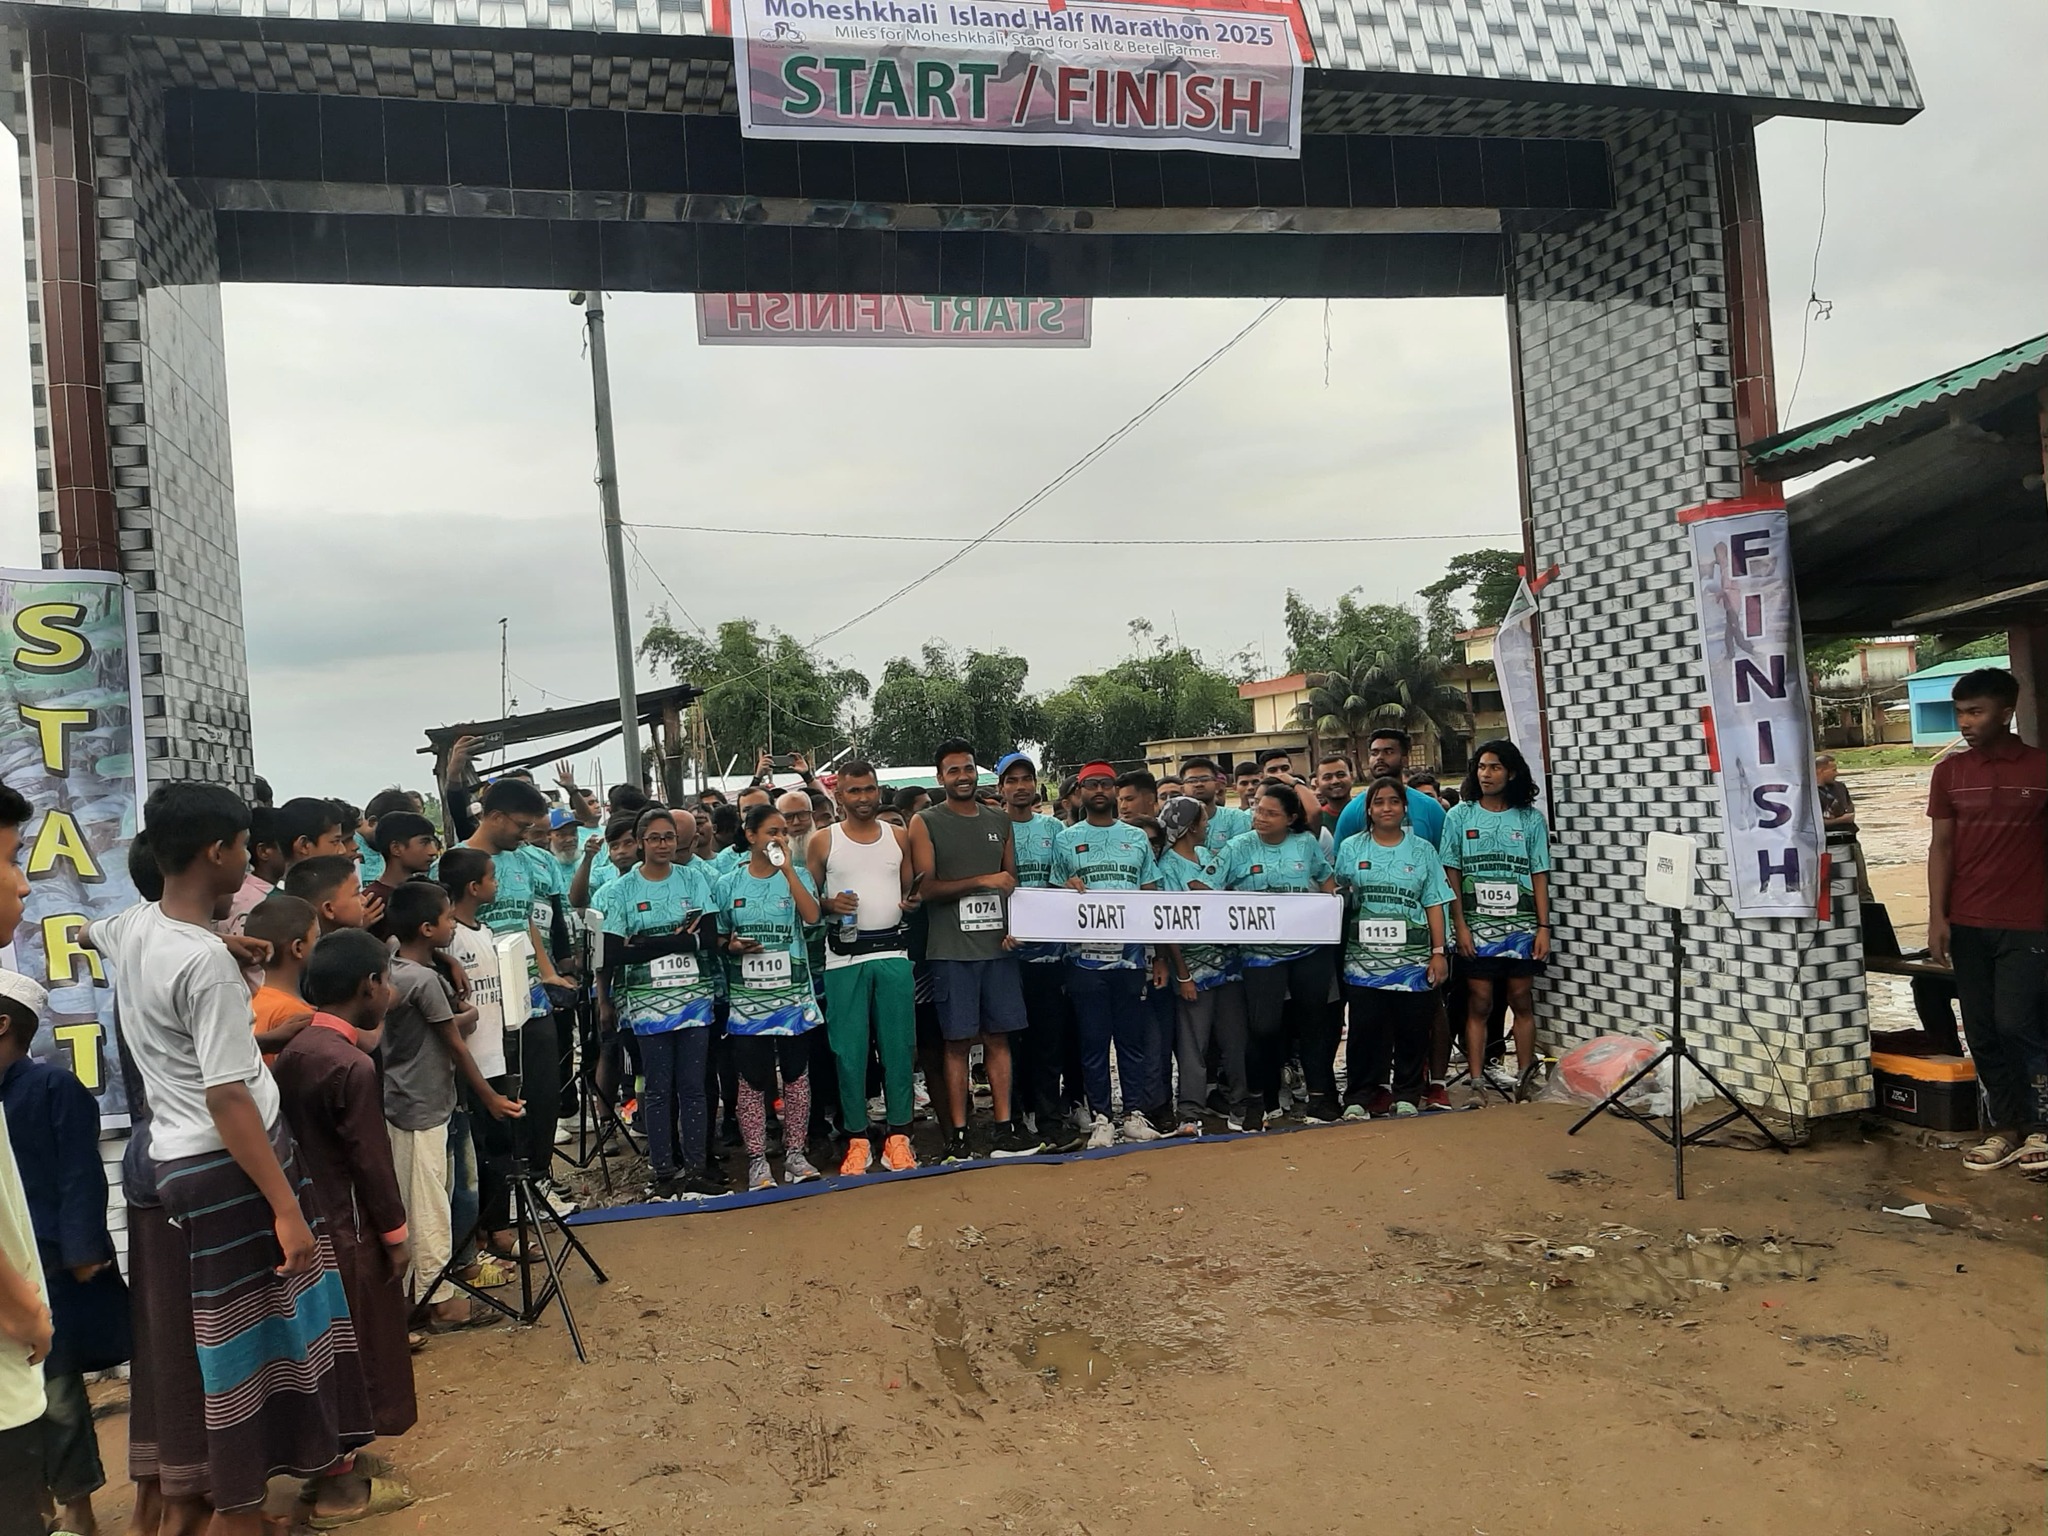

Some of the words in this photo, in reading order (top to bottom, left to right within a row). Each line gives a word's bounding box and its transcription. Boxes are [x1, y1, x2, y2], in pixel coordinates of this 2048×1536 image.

[766, 0, 938, 24] Moheshkhali
[951, 6, 1026, 28] Island
[1033, 10, 1083, 32] Half
[1091, 14, 1209, 41] Marathon
[1215, 23, 1274, 46] 2025
[835, 26, 876, 40] Miles
[880, 27, 901, 40] for
[1011, 34, 1054, 48] Stand
[1058, 36, 1079, 49] for
[1082, 38, 1109, 51] Salt
[1113, 40, 1124, 52] &
[1128, 41, 1163, 54] Betel
[1168, 44, 1220, 58] Farmer.
[783, 55, 999, 119] START
[1057, 66, 1263, 134] FINISH
[1730, 528, 1800, 894] FINISH
[13, 602, 106, 1096] START
[966, 902, 997, 914] 1074
[1480, 889, 1511, 901] 1054
[1078, 904, 1126, 929] START
[1153, 905, 1201, 930] START
[1228, 906, 1276, 930] START
[1365, 926, 1398, 938] 1113
[658, 957, 691, 970] 1106
[748, 959, 783, 972] 1110
